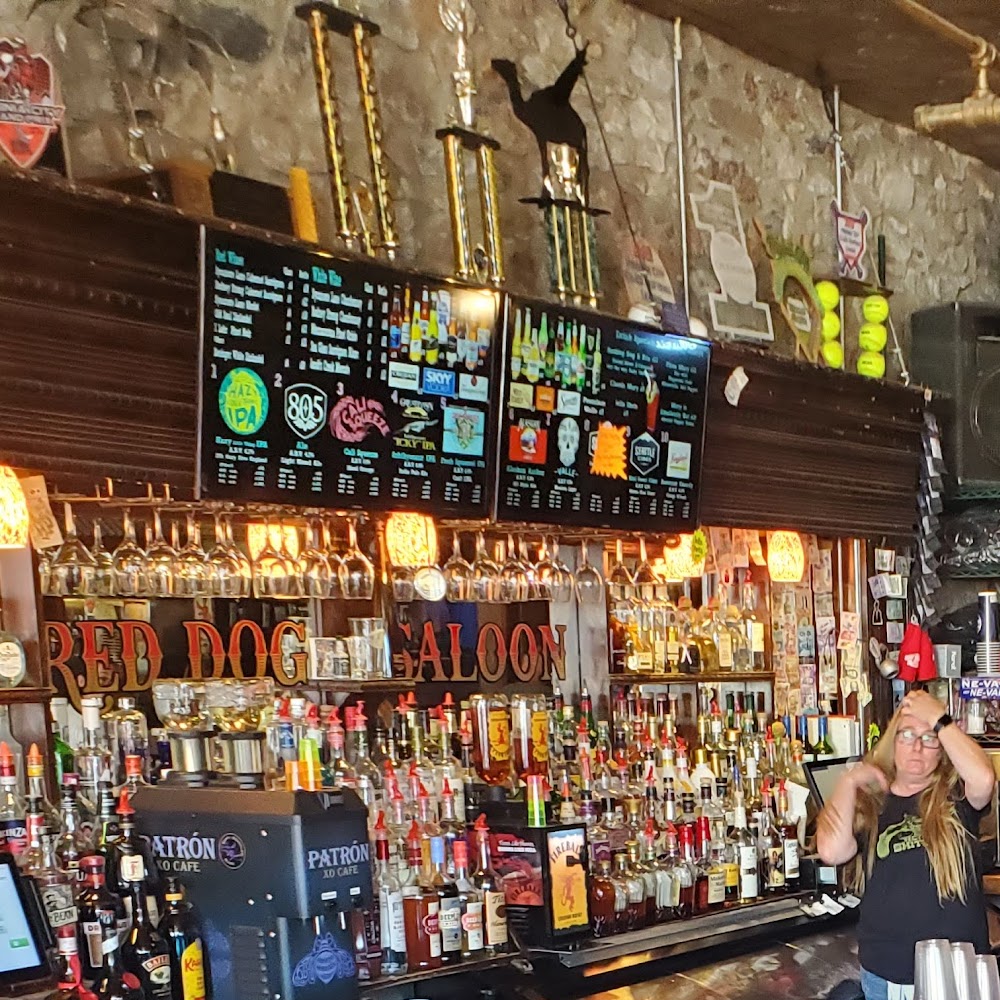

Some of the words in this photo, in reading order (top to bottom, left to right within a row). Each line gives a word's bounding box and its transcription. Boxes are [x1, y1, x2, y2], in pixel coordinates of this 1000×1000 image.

[274, 372, 282, 388] 2
[426, 370, 453, 385] SKYY
[336, 382, 344, 396] 3
[287, 392, 324, 423] 805
[228, 405, 257, 430] IPA
[44, 619, 163, 714] RED
[182, 619, 308, 687] DOG
[308, 840, 369, 869] PATRÓN
[173, 861, 201, 873] CAFE
[337, 865, 359, 877] CAFE
